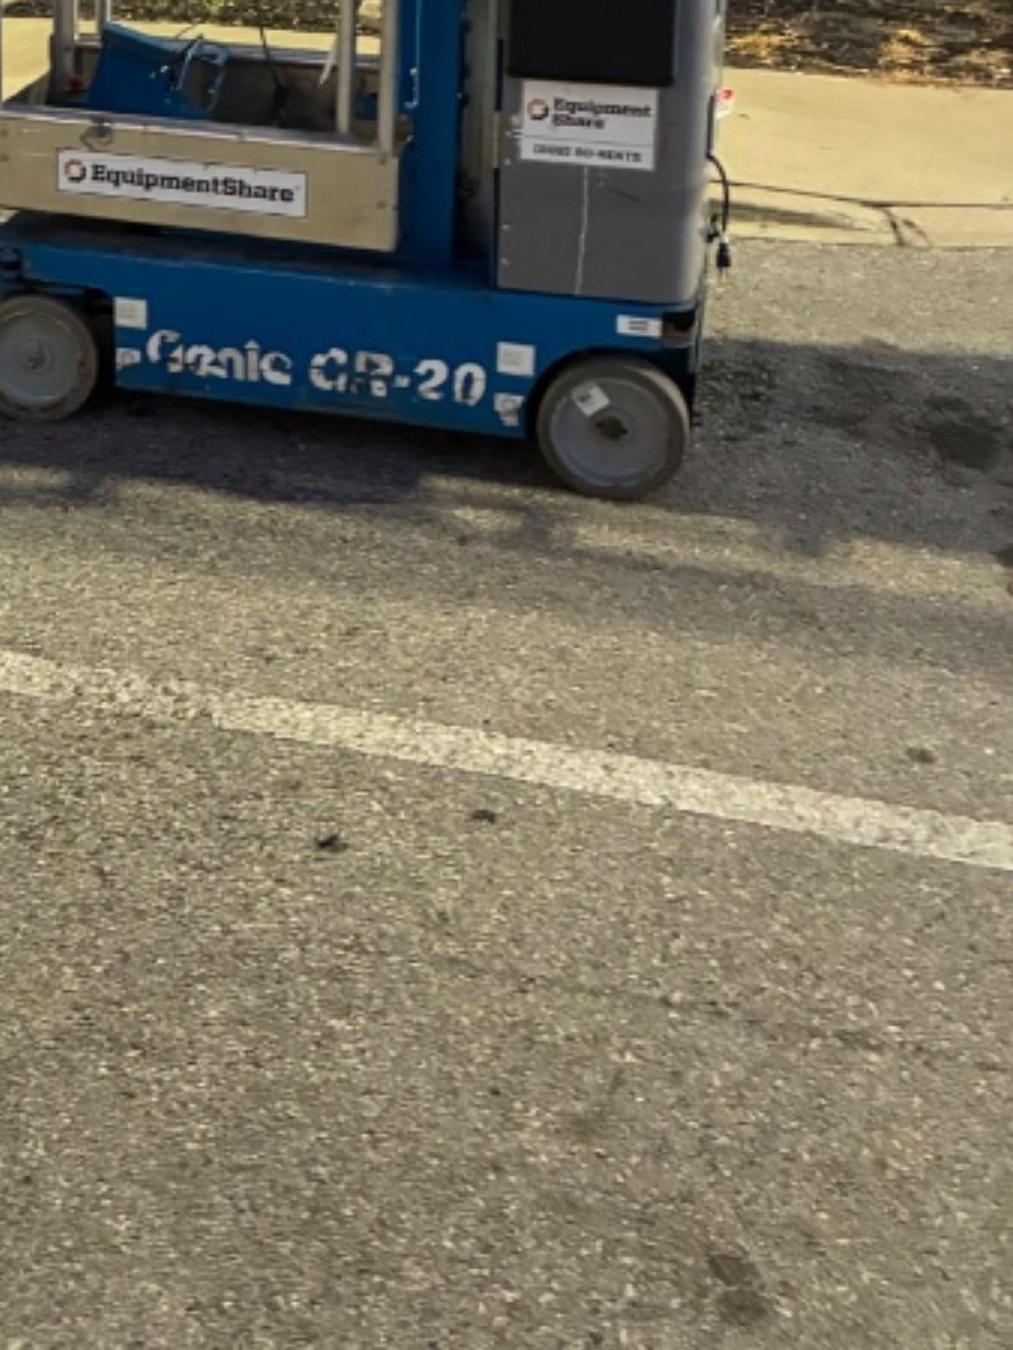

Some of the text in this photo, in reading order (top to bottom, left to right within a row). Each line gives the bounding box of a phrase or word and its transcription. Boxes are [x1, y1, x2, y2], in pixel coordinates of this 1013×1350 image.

[553, 98, 652, 117] Equipment
[553, 113, 605, 129] Share
[90, 164, 296, 202] EquipmentShare
